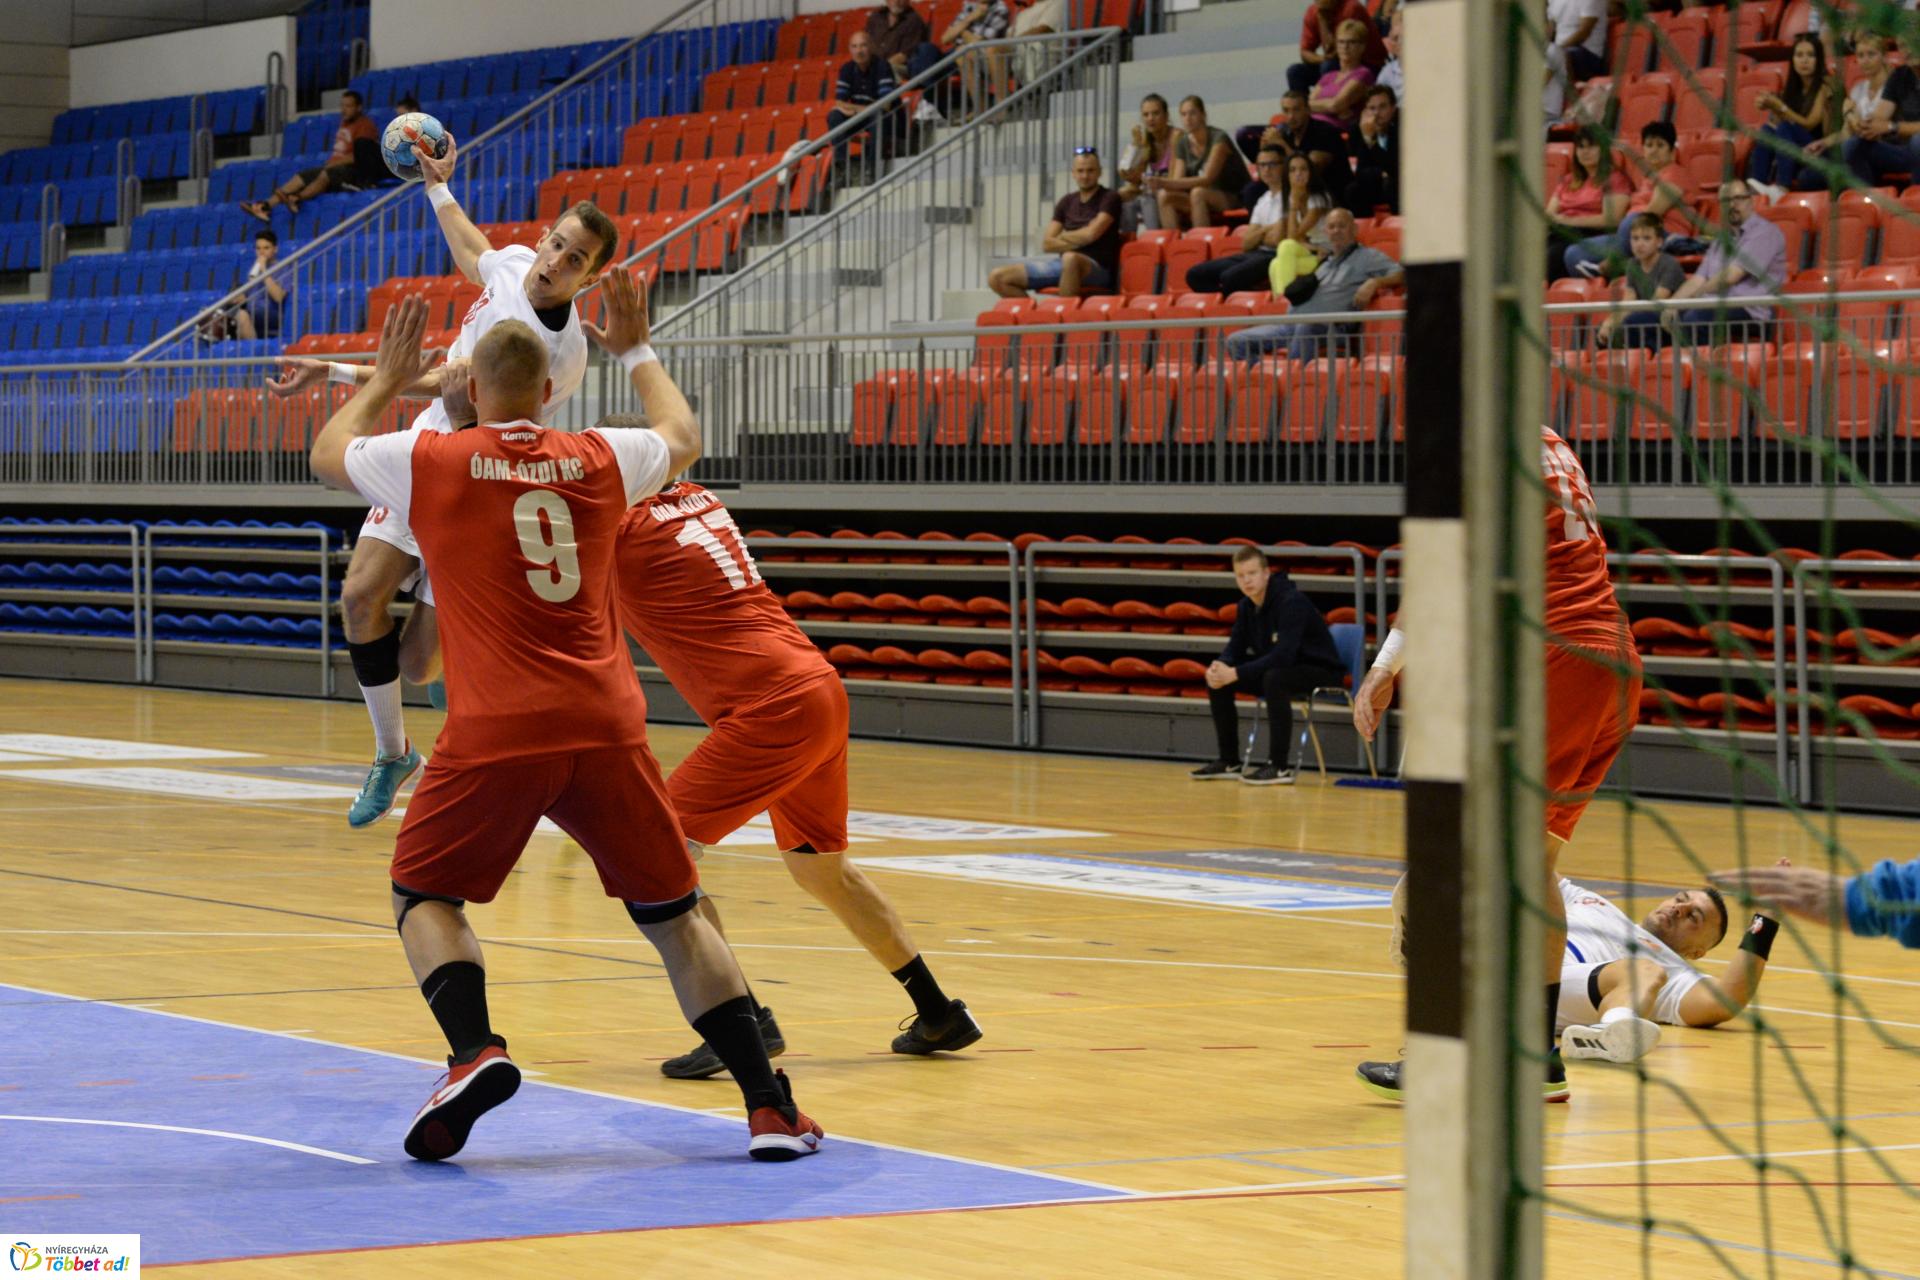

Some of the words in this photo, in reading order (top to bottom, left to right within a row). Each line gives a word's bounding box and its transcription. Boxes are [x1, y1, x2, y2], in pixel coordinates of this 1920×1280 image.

[501, 432, 537, 442] Kempa
[470, 452, 558, 484] ÓAM-ÓZDI
[558, 457, 585, 481] KC
[513, 489, 581, 603] 9
[675, 506, 762, 591] 17
